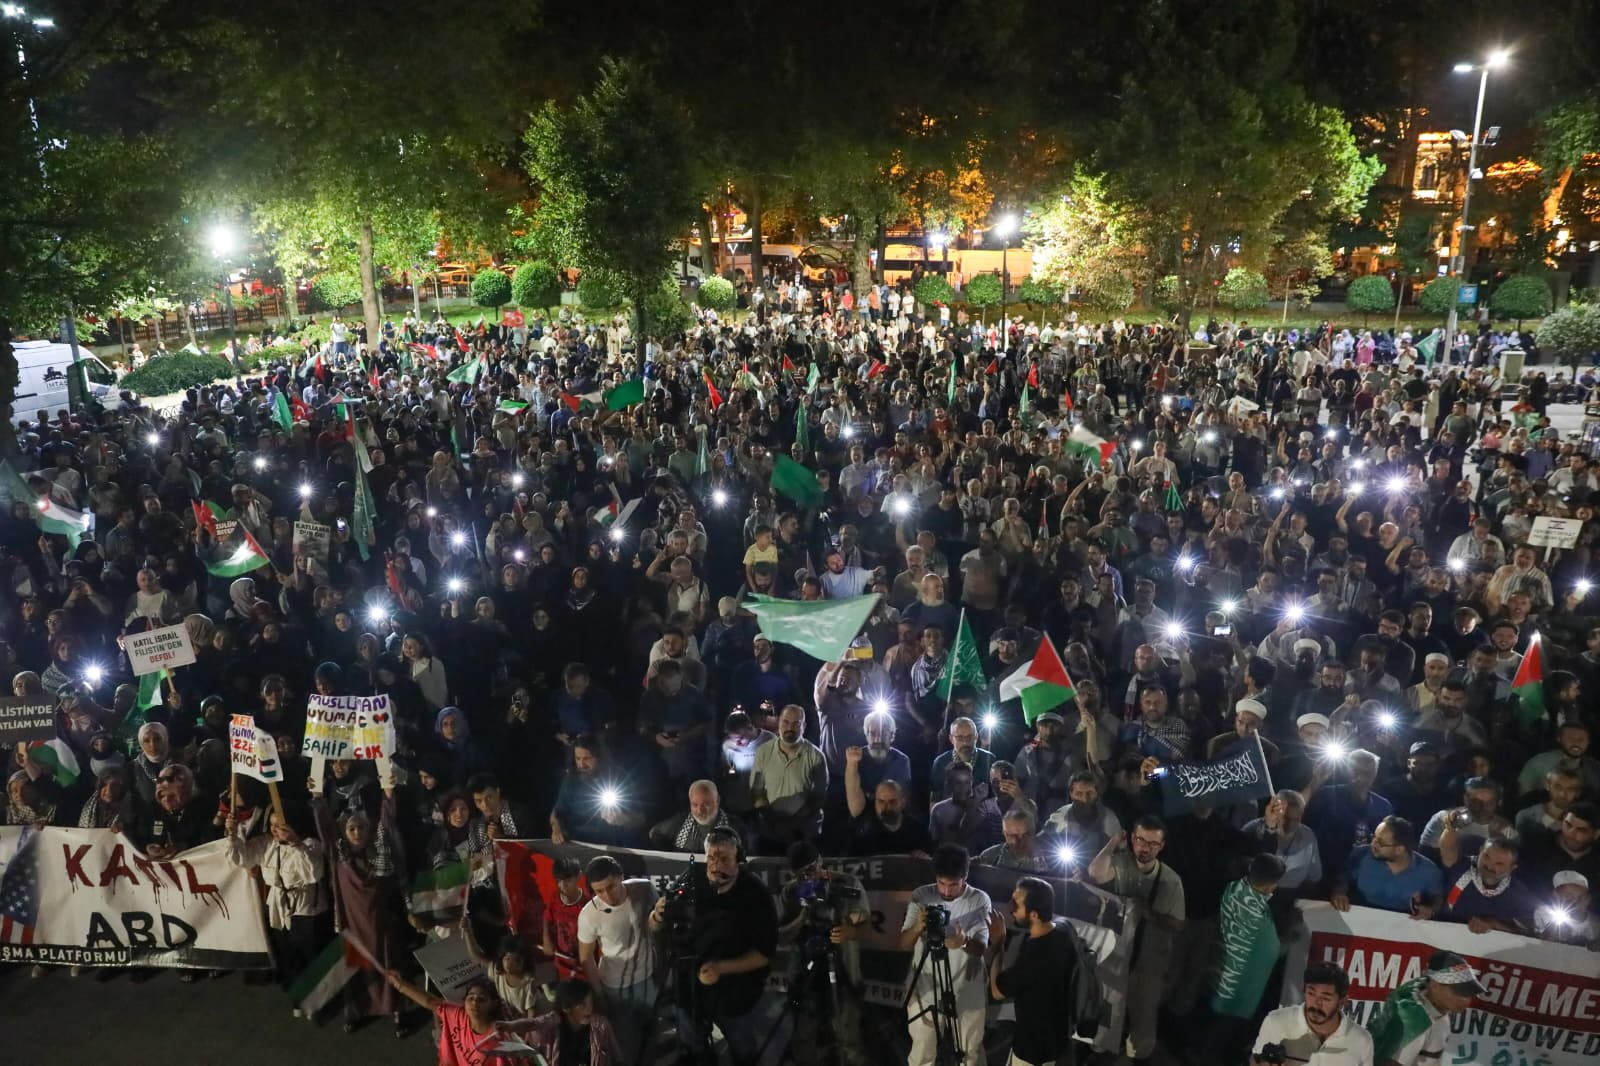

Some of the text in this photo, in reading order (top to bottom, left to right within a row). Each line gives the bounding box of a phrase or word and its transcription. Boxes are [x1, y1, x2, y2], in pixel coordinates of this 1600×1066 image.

[133, 636, 153, 648] KATİL
[149, 652, 176, 663] DEFOL!
[33, 719, 53, 727] VAR
[303, 738, 348, 757] SAHİP
[86, 911, 198, 950] ABD
[39, 948, 127, 962] PLATFORMU
[1474, 963, 1600, 1021] ĞİLME
[1449, 1009, 1600, 1057] UNBOWED
